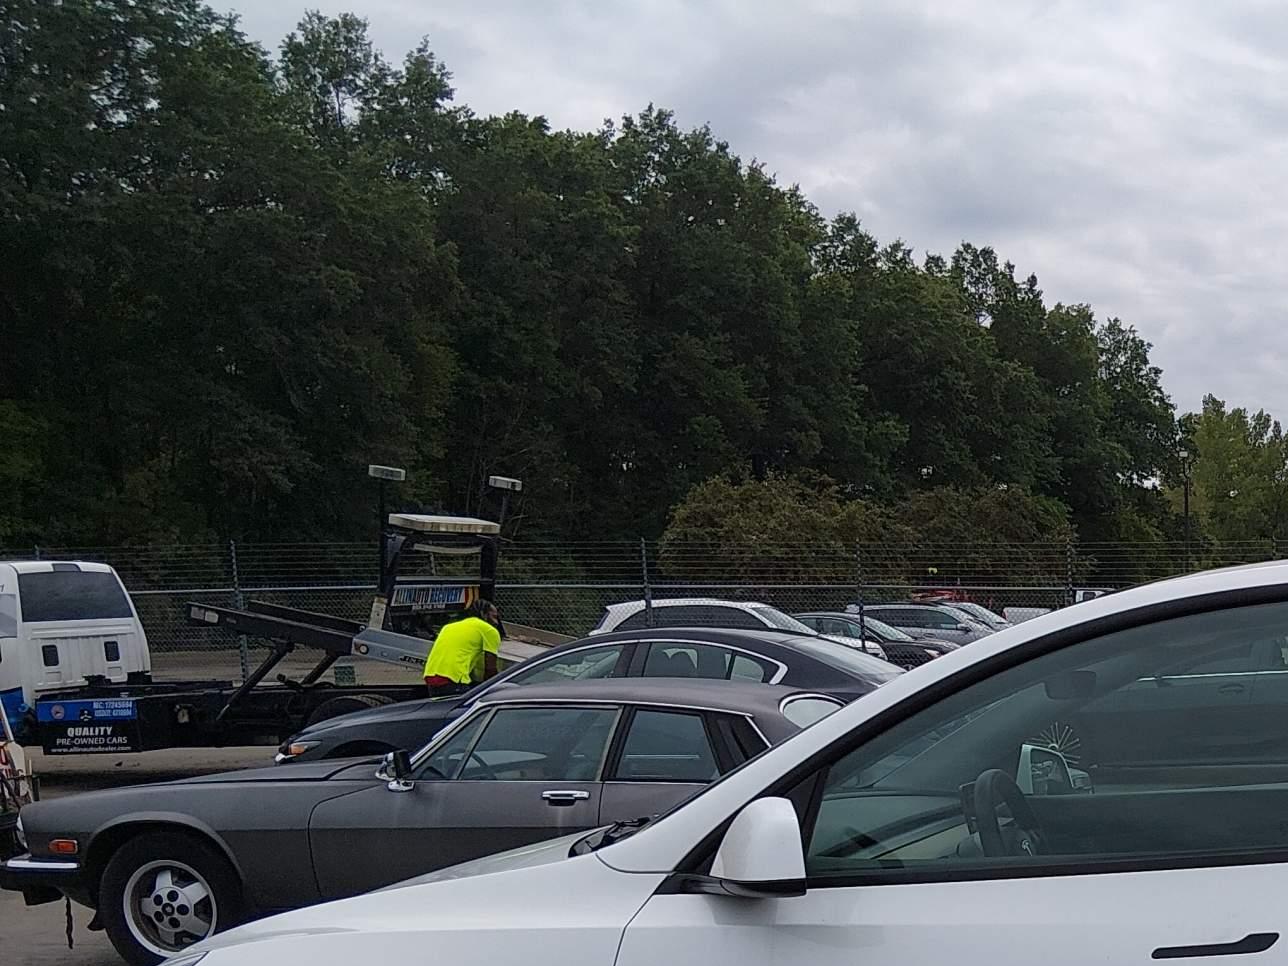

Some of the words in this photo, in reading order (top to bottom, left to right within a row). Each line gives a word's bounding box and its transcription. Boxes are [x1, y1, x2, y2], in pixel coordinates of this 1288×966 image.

[67, 726, 113, 737] QUALITY
[56, 737, 105, 745] PRE-OWNED
[106, 736, 128, 744] CARS
